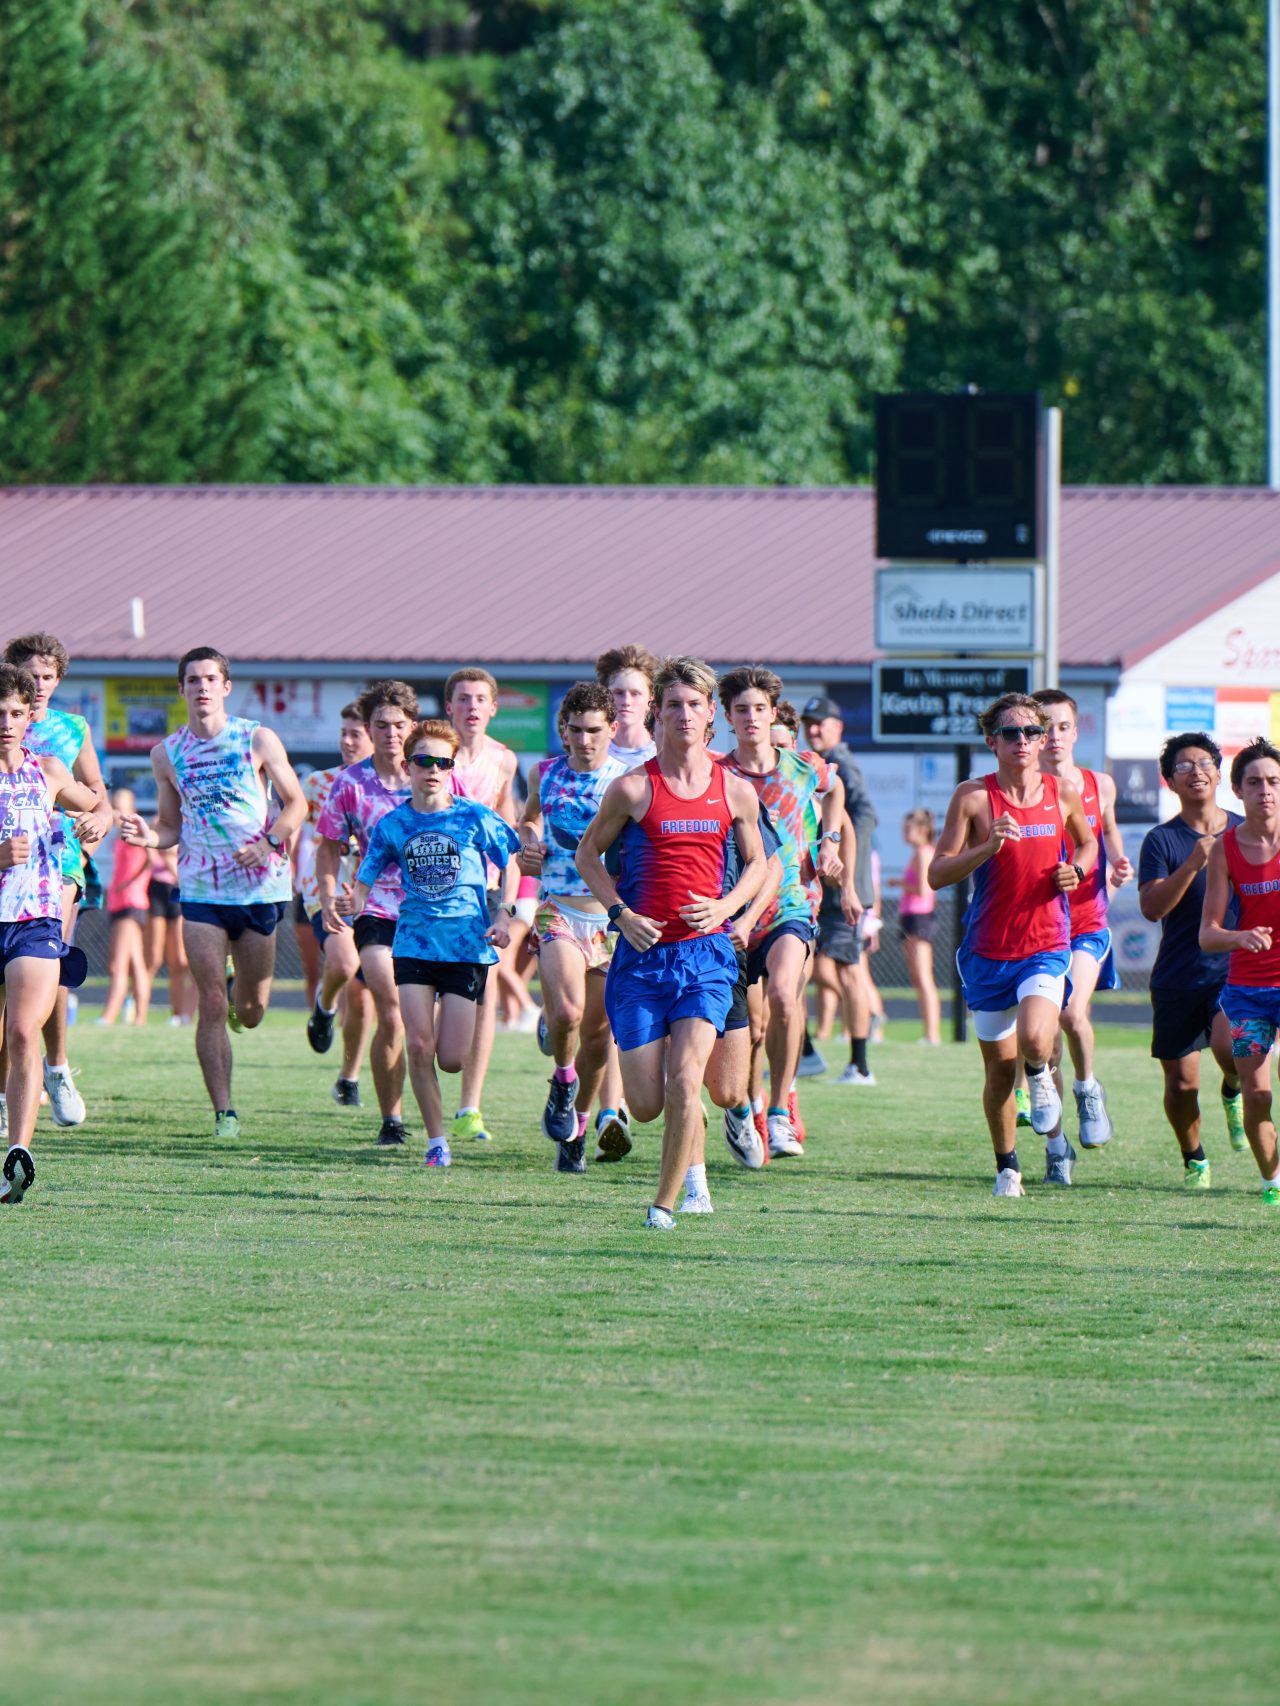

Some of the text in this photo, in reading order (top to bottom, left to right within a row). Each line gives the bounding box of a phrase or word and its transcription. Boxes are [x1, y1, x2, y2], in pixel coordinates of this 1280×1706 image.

[894, 599, 1027, 622] Sheds Direct
[903, 669, 1005, 692] In Memory of
[882, 692, 944, 715] Kevin
[4, 812, 15, 827] &
[661, 820, 720, 833] FREEDOM
[407, 854, 461, 872] PIONEER
[1240, 880, 1280, 896] FREEDO
